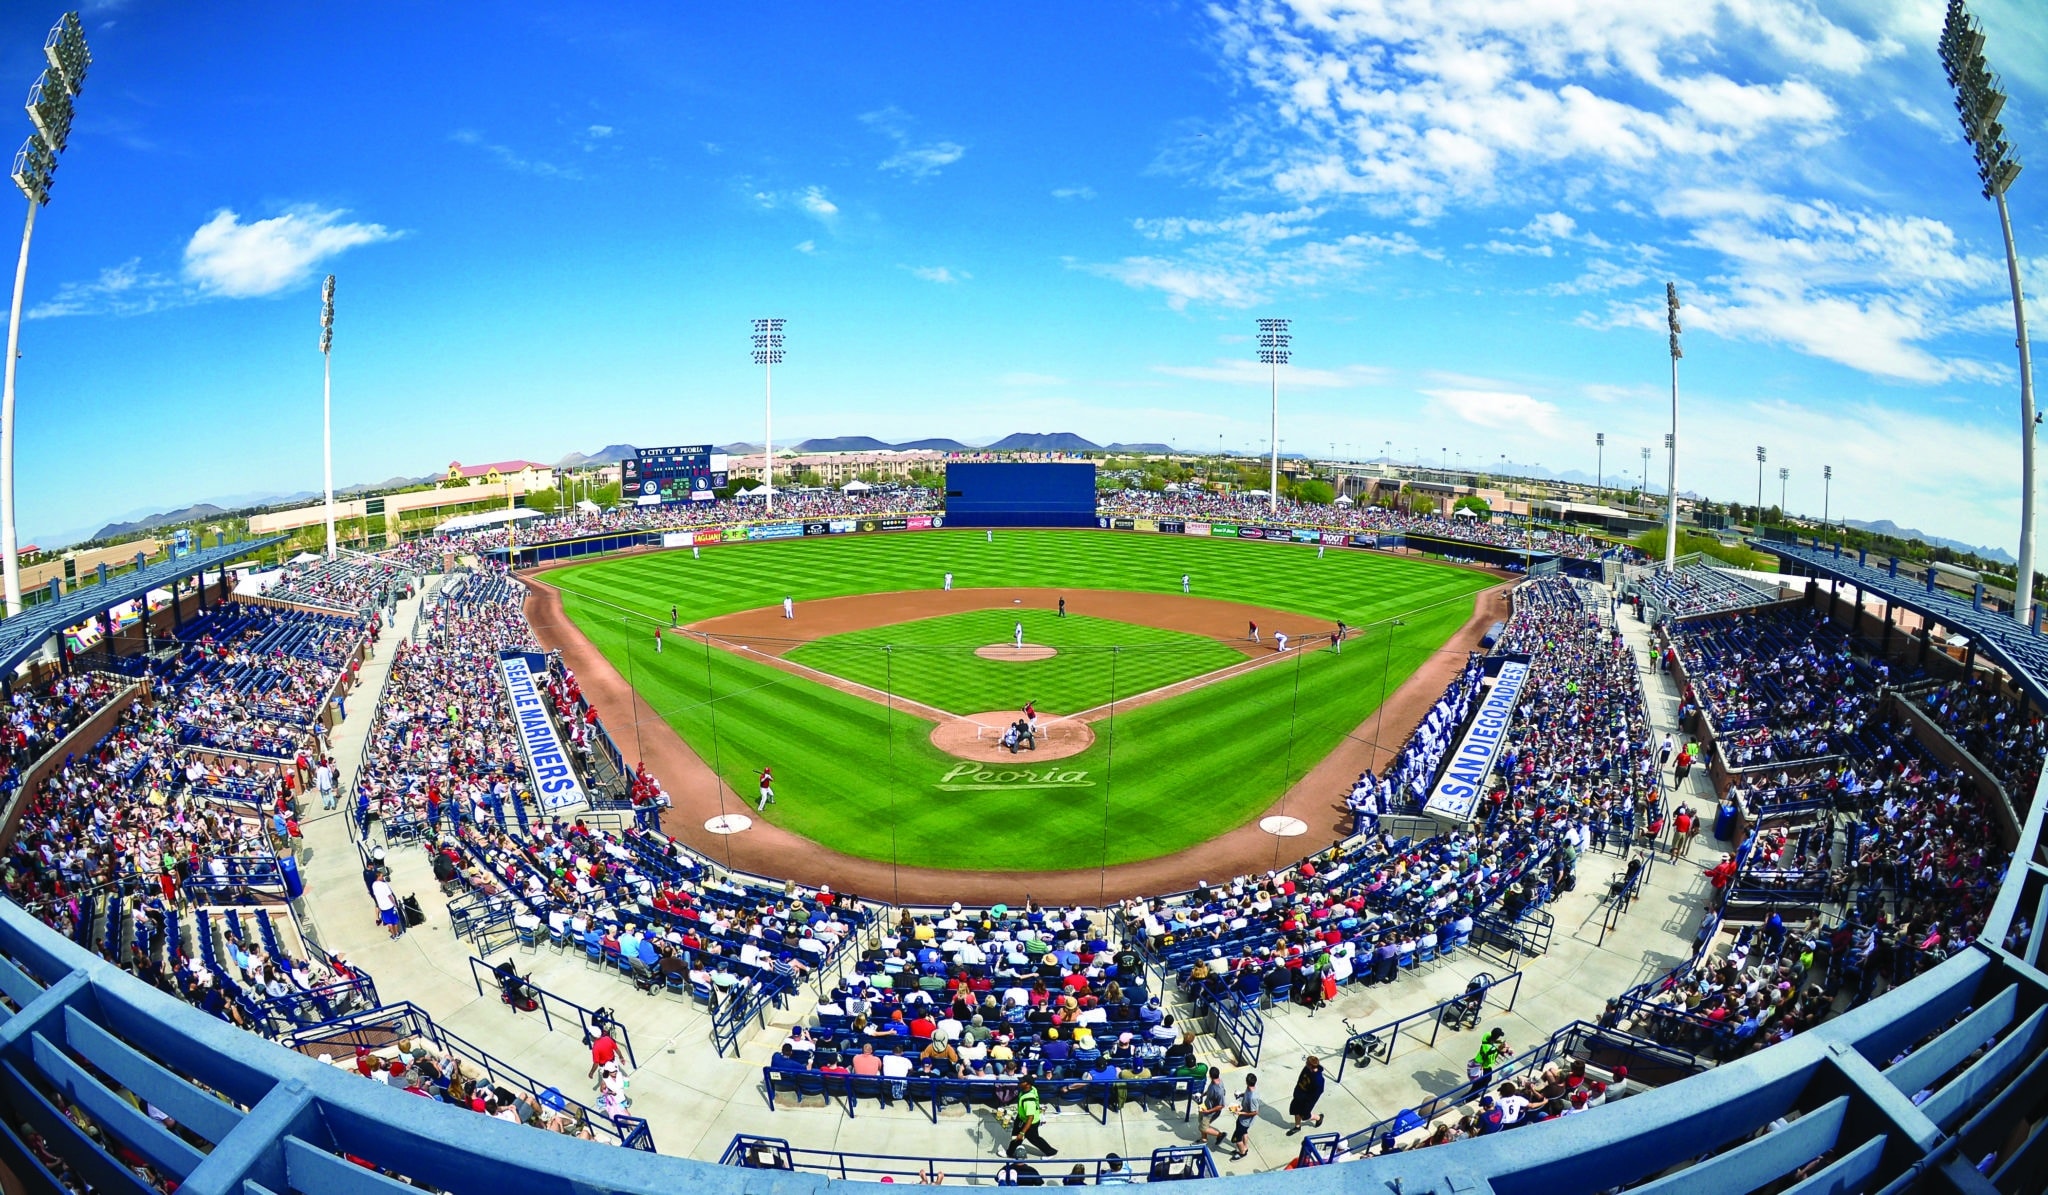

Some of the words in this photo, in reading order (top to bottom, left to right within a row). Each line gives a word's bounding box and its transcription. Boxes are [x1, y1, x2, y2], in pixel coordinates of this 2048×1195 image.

[1492, 511, 1514, 519] KONA
[1322, 534, 1345, 542] ROOT
[506, 664, 538, 707] SEATTLE
[1440, 757, 1486, 798] SAN
[1463, 709, 1506, 757] DIEGO
[1487, 668, 1524, 709] PADRES
[519, 709, 575, 793] MARINERS
[939, 761, 1092, 785] Peoria
[1508, 1105, 1514, 1115] 6
